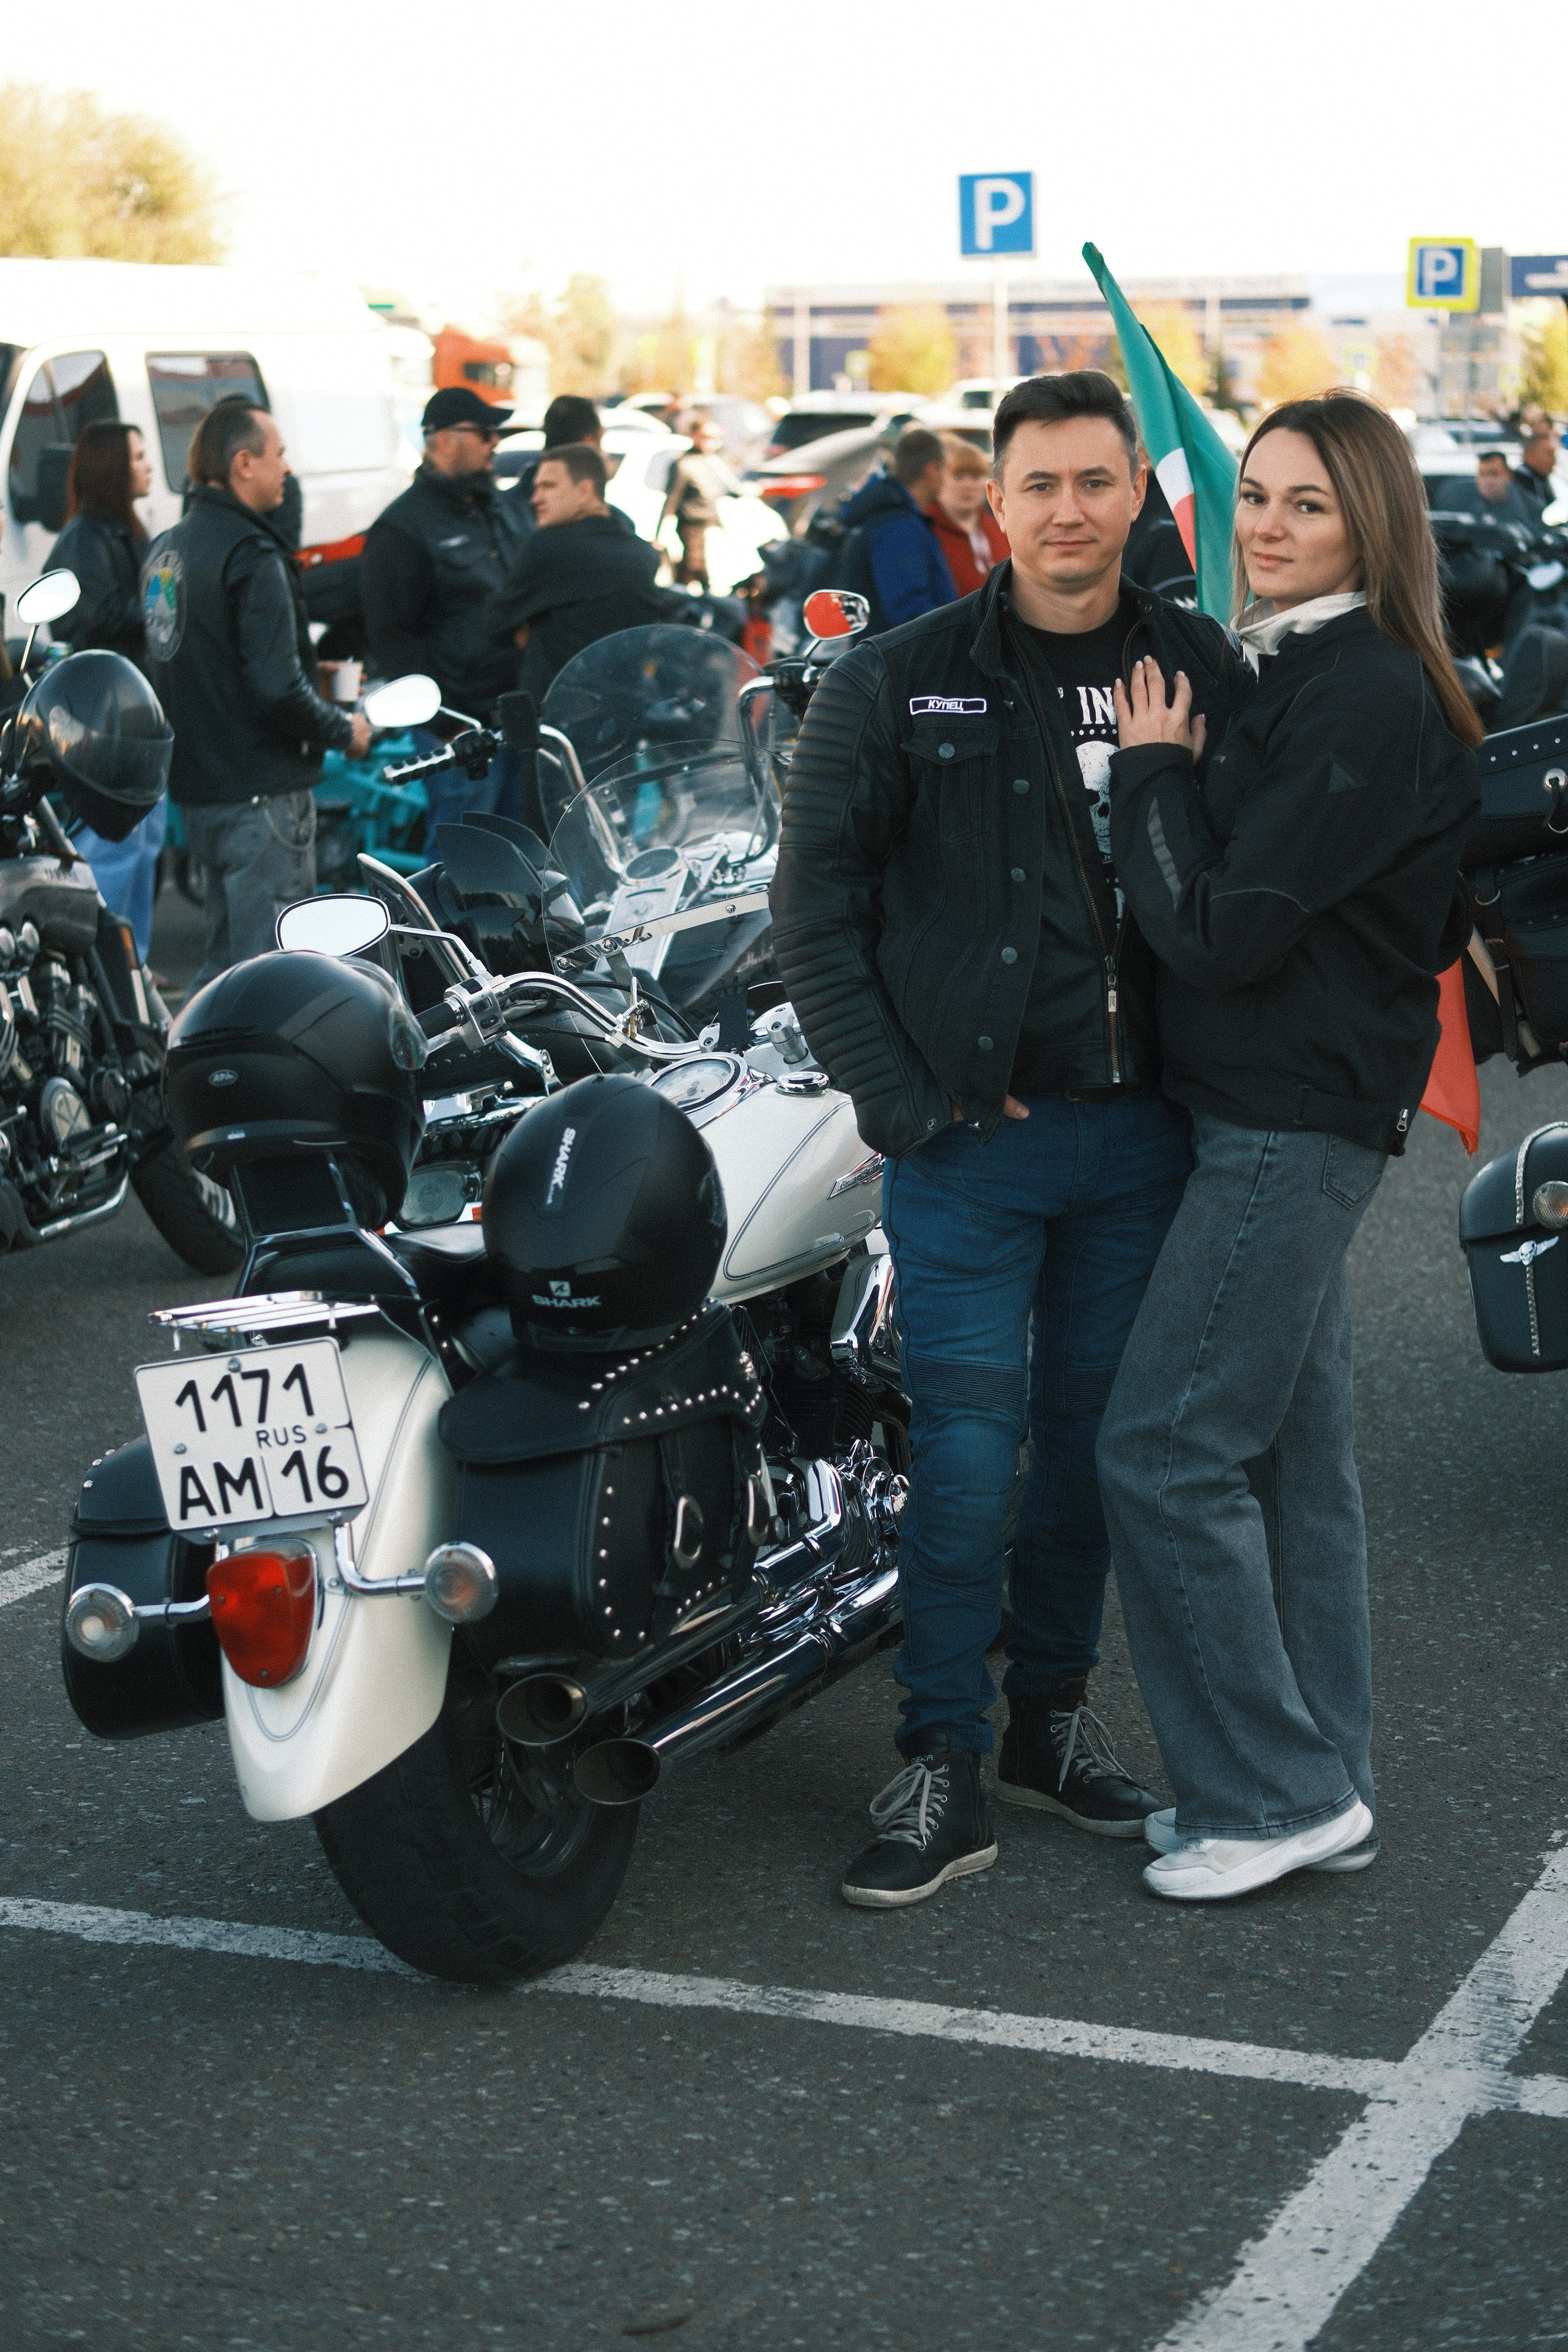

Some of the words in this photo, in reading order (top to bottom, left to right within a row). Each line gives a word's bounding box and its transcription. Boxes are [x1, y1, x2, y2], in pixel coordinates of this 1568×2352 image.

[974, 178, 1025, 250] P
[1423, 249, 1458, 296] P
[927, 699, 963, 711] КУПЕЦ
[552, 1127, 576, 1189] SHARK
[532, 1294, 601, 1309] SHARK
[175, 1363, 314, 1432] 1171
[256, 1425, 307, 1448] RUS
[180, 1457, 264, 1520] AM
[281, 1446, 349, 1503] 16
